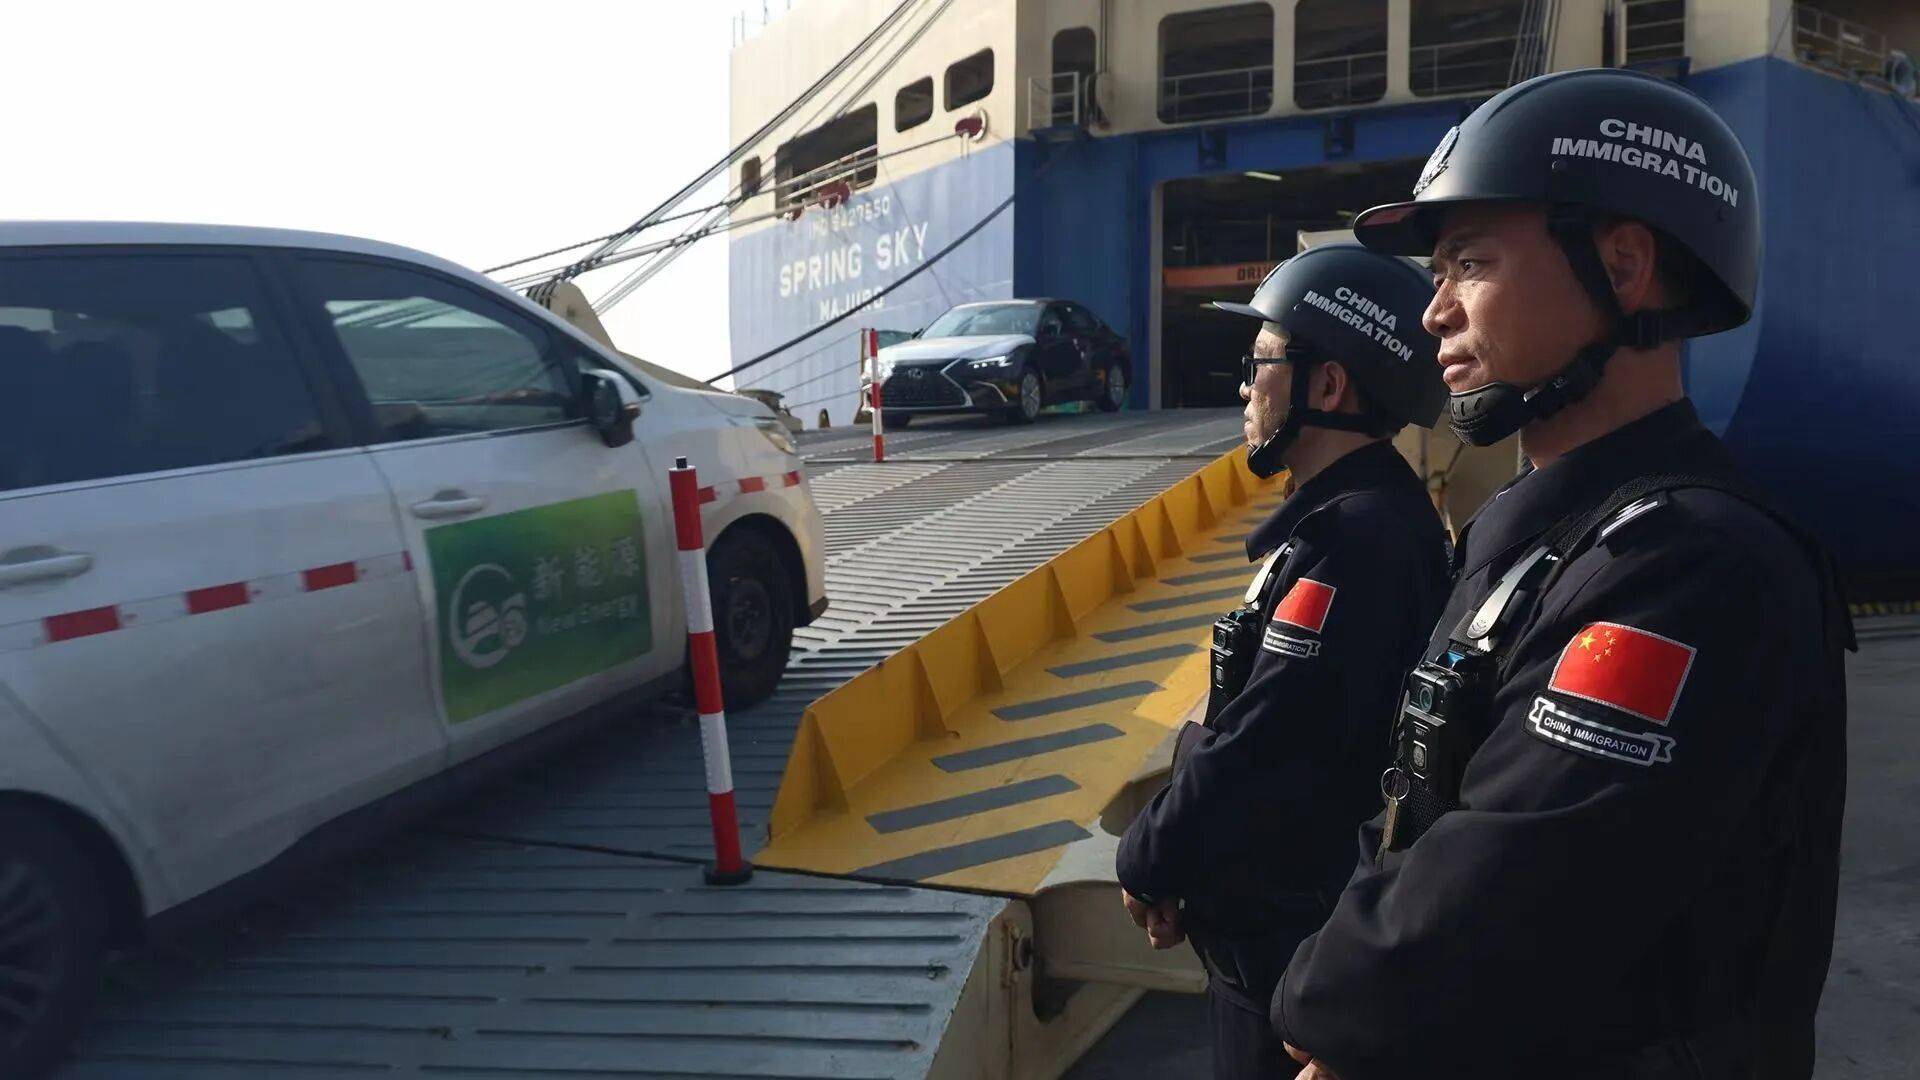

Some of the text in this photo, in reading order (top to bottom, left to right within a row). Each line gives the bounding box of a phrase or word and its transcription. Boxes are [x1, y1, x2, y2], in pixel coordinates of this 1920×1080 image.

[1551, 137, 1739, 207] IMMIGRATION
[1600, 118, 1707, 166] CHINA
[780, 221, 929, 297] SPRING SKY
[1303, 290, 1413, 362] IMMIGRATION
[1334, 286, 1397, 331] CHINA
[531, 536, 640, 600] 新能源
[1543, 716, 1648, 757] CHINA IMMIGRATION
